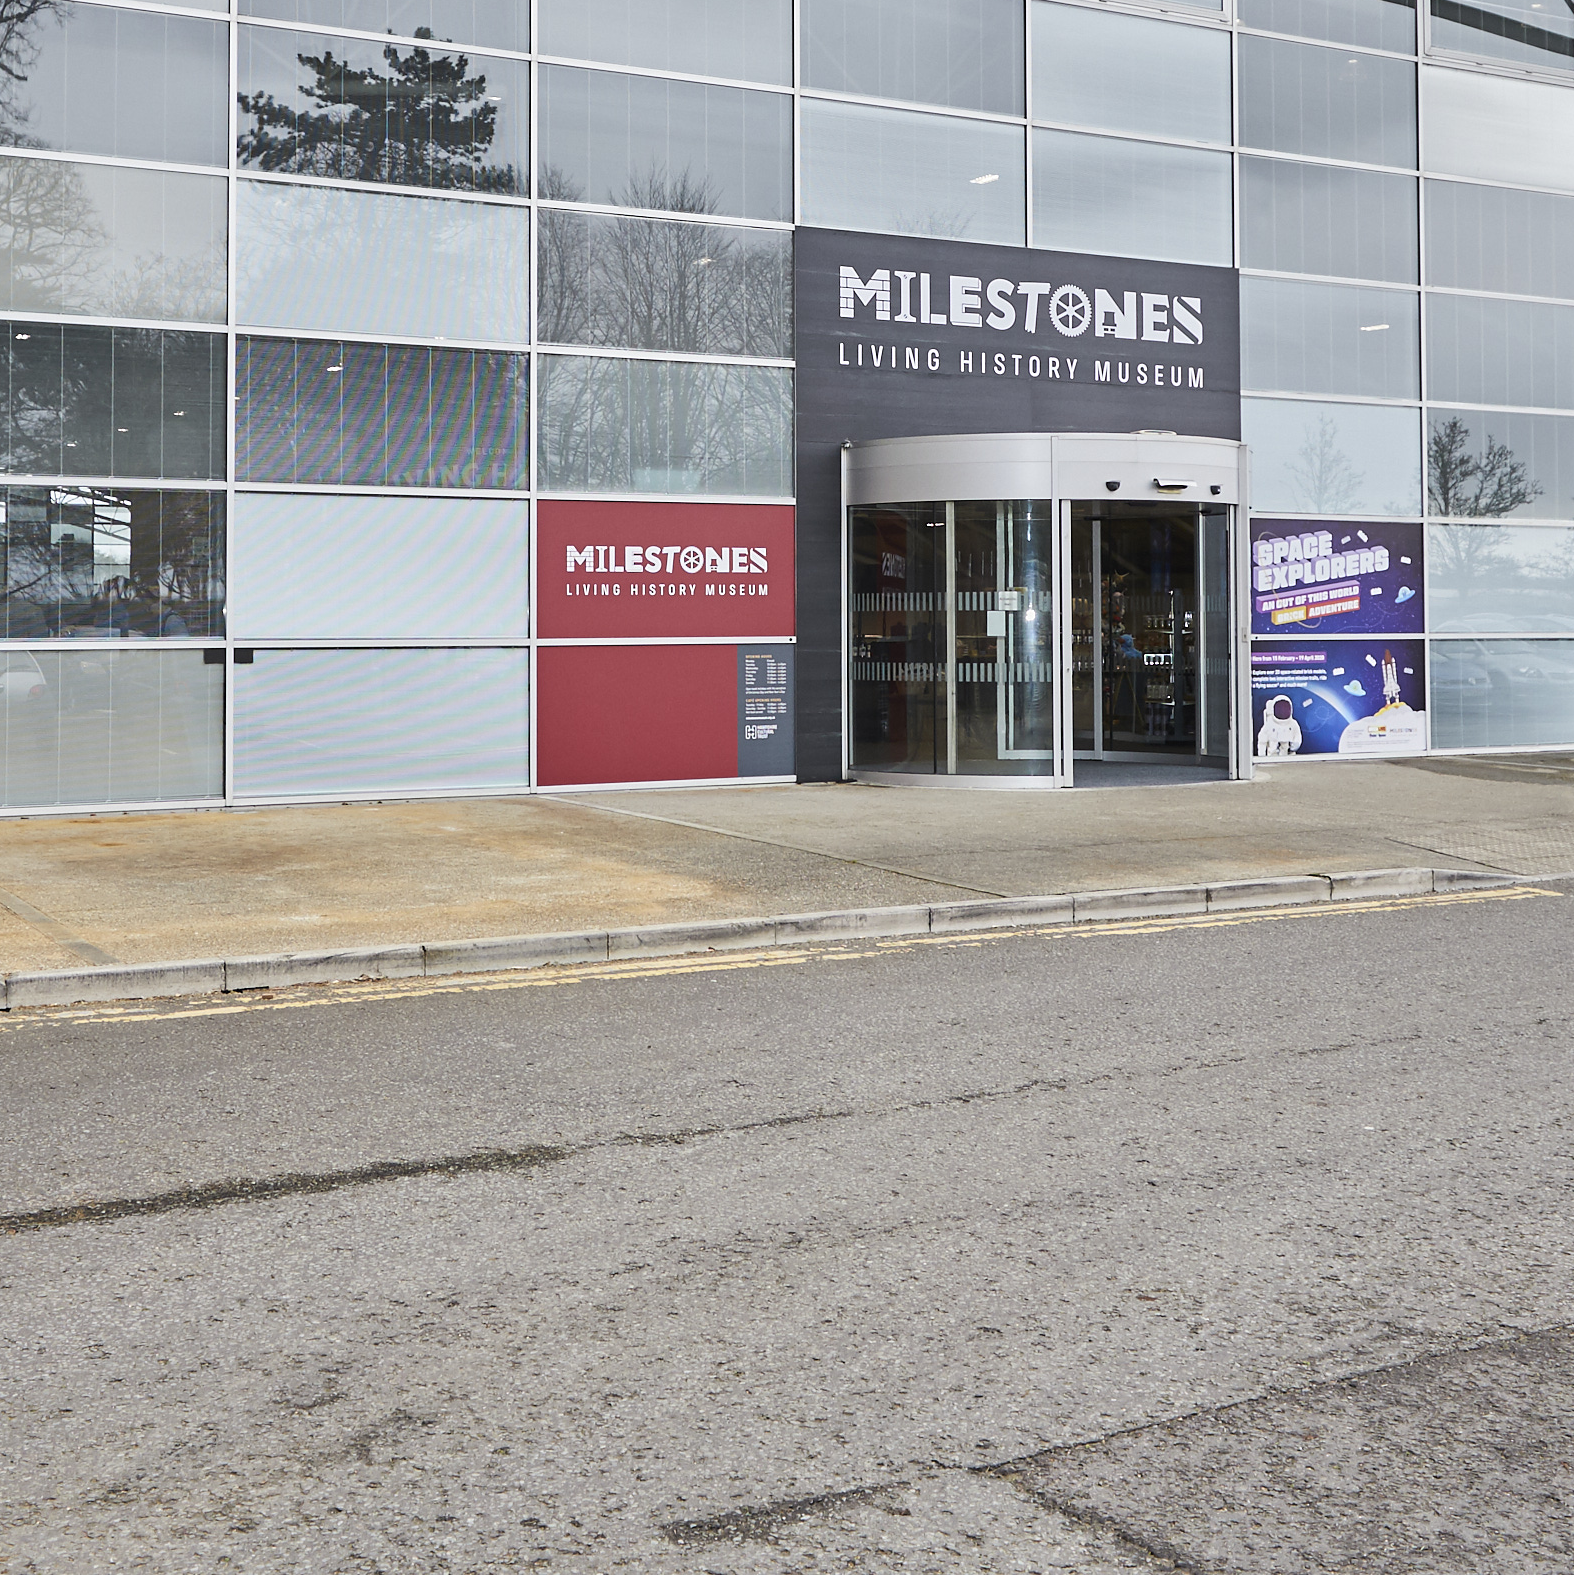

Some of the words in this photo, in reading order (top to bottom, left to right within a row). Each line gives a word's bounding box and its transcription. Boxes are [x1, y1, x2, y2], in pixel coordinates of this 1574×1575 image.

[839, 265, 1203, 345] MILESTONES
[839, 342, 940, 371] LIVING
[960, 350, 1078, 380] HISTORY
[1094, 360, 1204, 389] MUSEUM
[566, 545, 768, 574] MILESTONES
[1253, 530, 1333, 566] SPACE
[1254, 546, 1389, 592] EXPLORERS
[566, 584, 621, 596] LIVING
[630, 584, 696, 596] HISTORY
[705, 584, 768, 596] MUSEUM
[1262, 601, 1275, 612] AN
[1276, 596, 1294, 609] OUT
[1295, 594, 1307, 606] OF
[1308, 591, 1328, 604] THIS
[1329, 586, 1359, 600] WORLD
[1309, 599, 1359, 618] ADVENTURE
